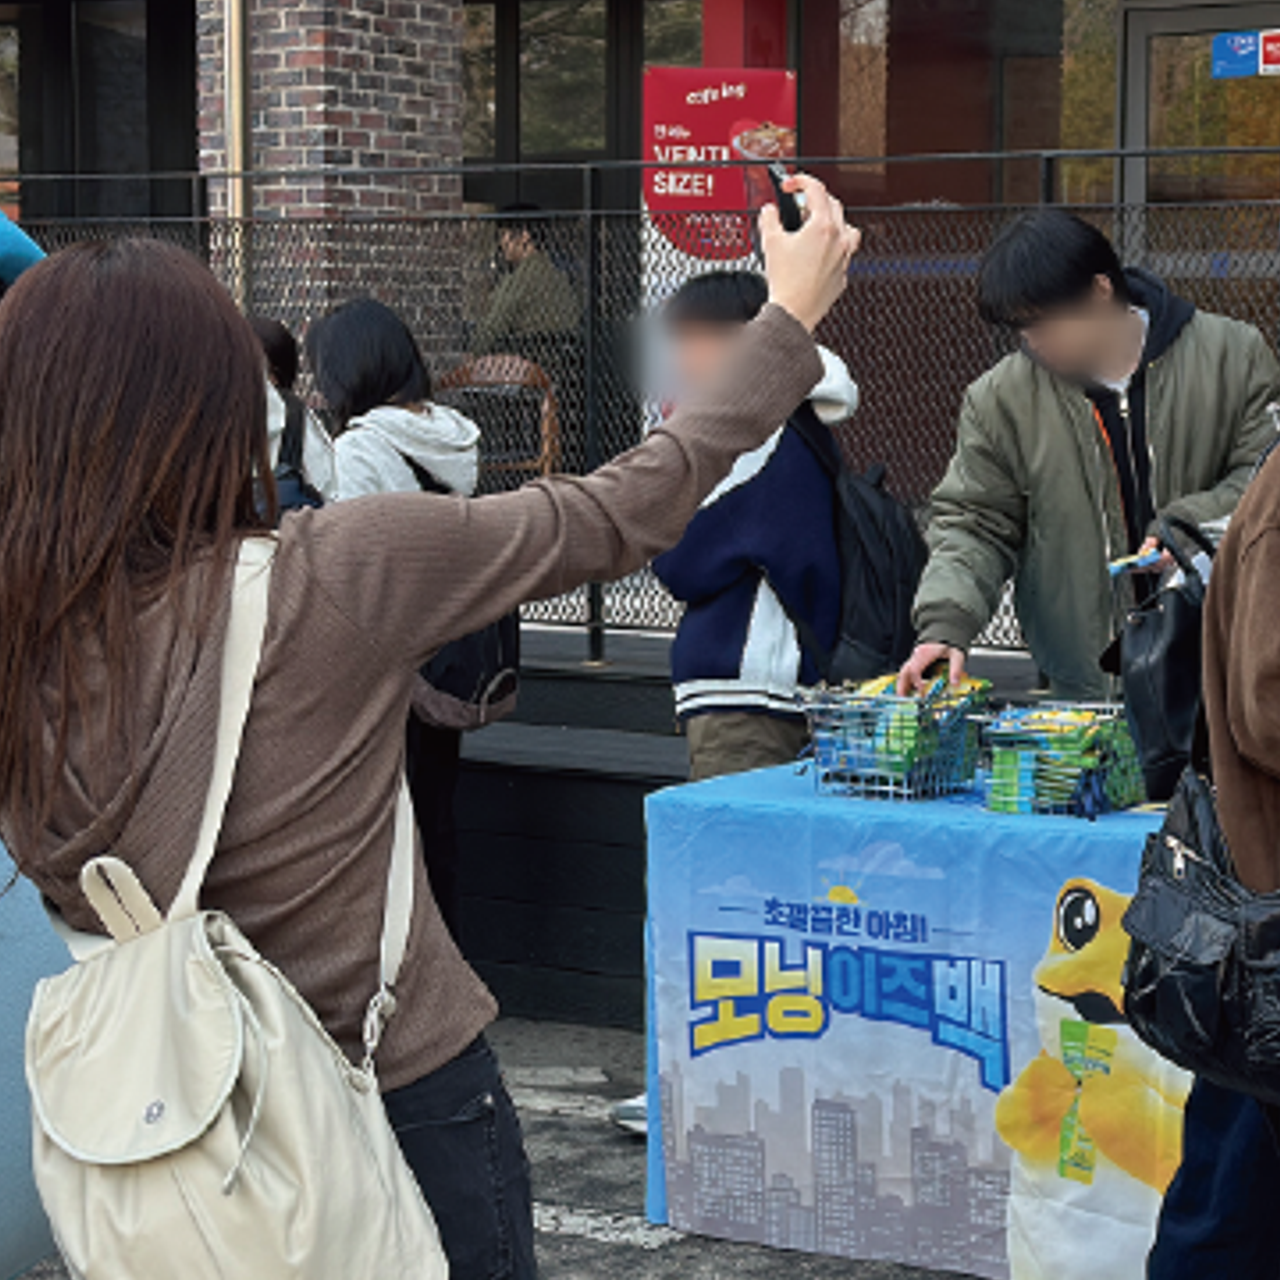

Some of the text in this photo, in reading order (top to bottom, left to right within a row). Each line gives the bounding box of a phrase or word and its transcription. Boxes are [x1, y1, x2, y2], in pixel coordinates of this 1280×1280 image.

[652, 144, 731, 167] VENTI
[652, 171, 714, 197] SIZE!
[687, 931, 1010, 1093] 모닝이즈백
